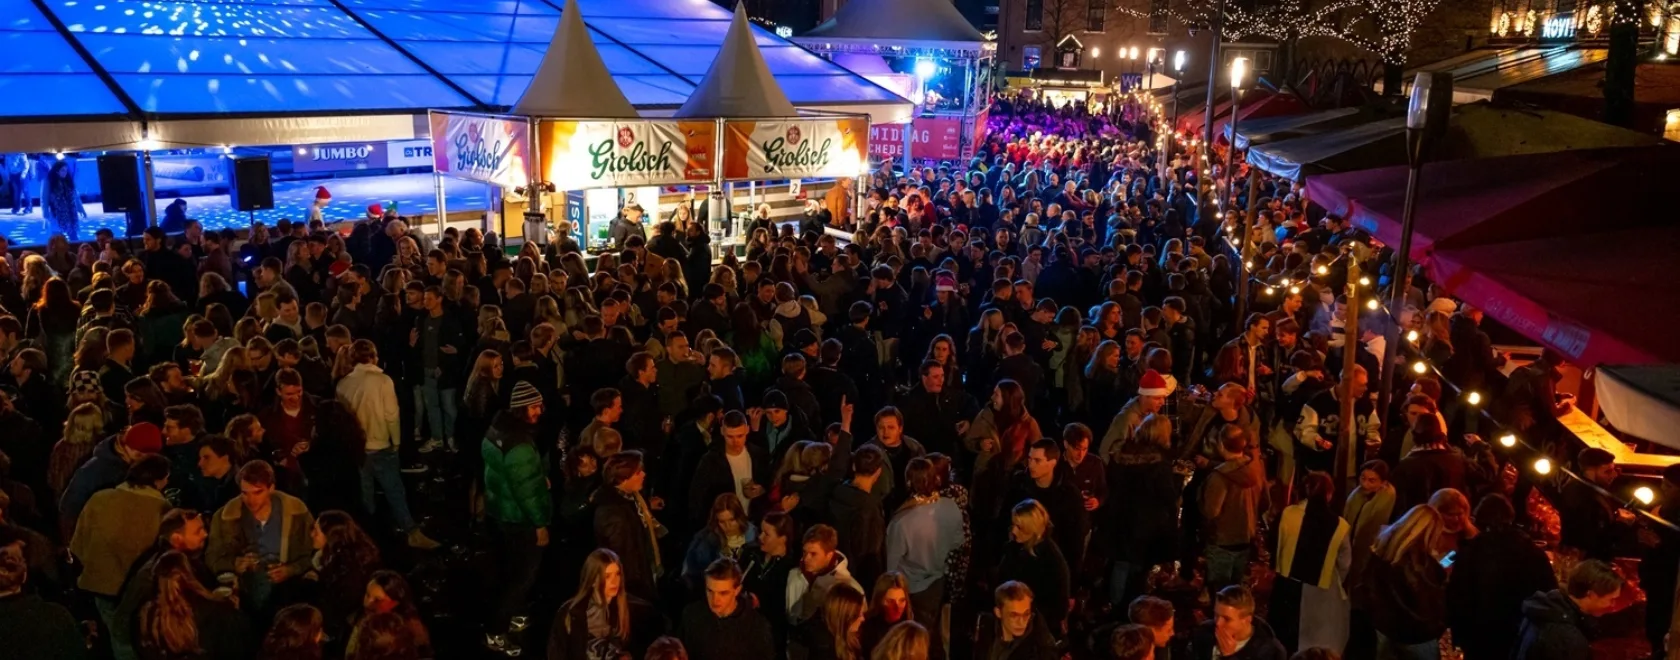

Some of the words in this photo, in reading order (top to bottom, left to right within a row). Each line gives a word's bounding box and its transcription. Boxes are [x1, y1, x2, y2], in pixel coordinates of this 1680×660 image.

[1122, 75, 1141, 87] WC
[870, 127, 930, 143] MIDAG
[313, 146, 368, 161] JUMBO
[455, 133, 501, 170] Grolsch
[763, 137, 832, 173] Grolsch
[588, 139, 672, 180] Grolsch
[791, 185, 798, 194] 2
[627, 192, 635, 203] 2
